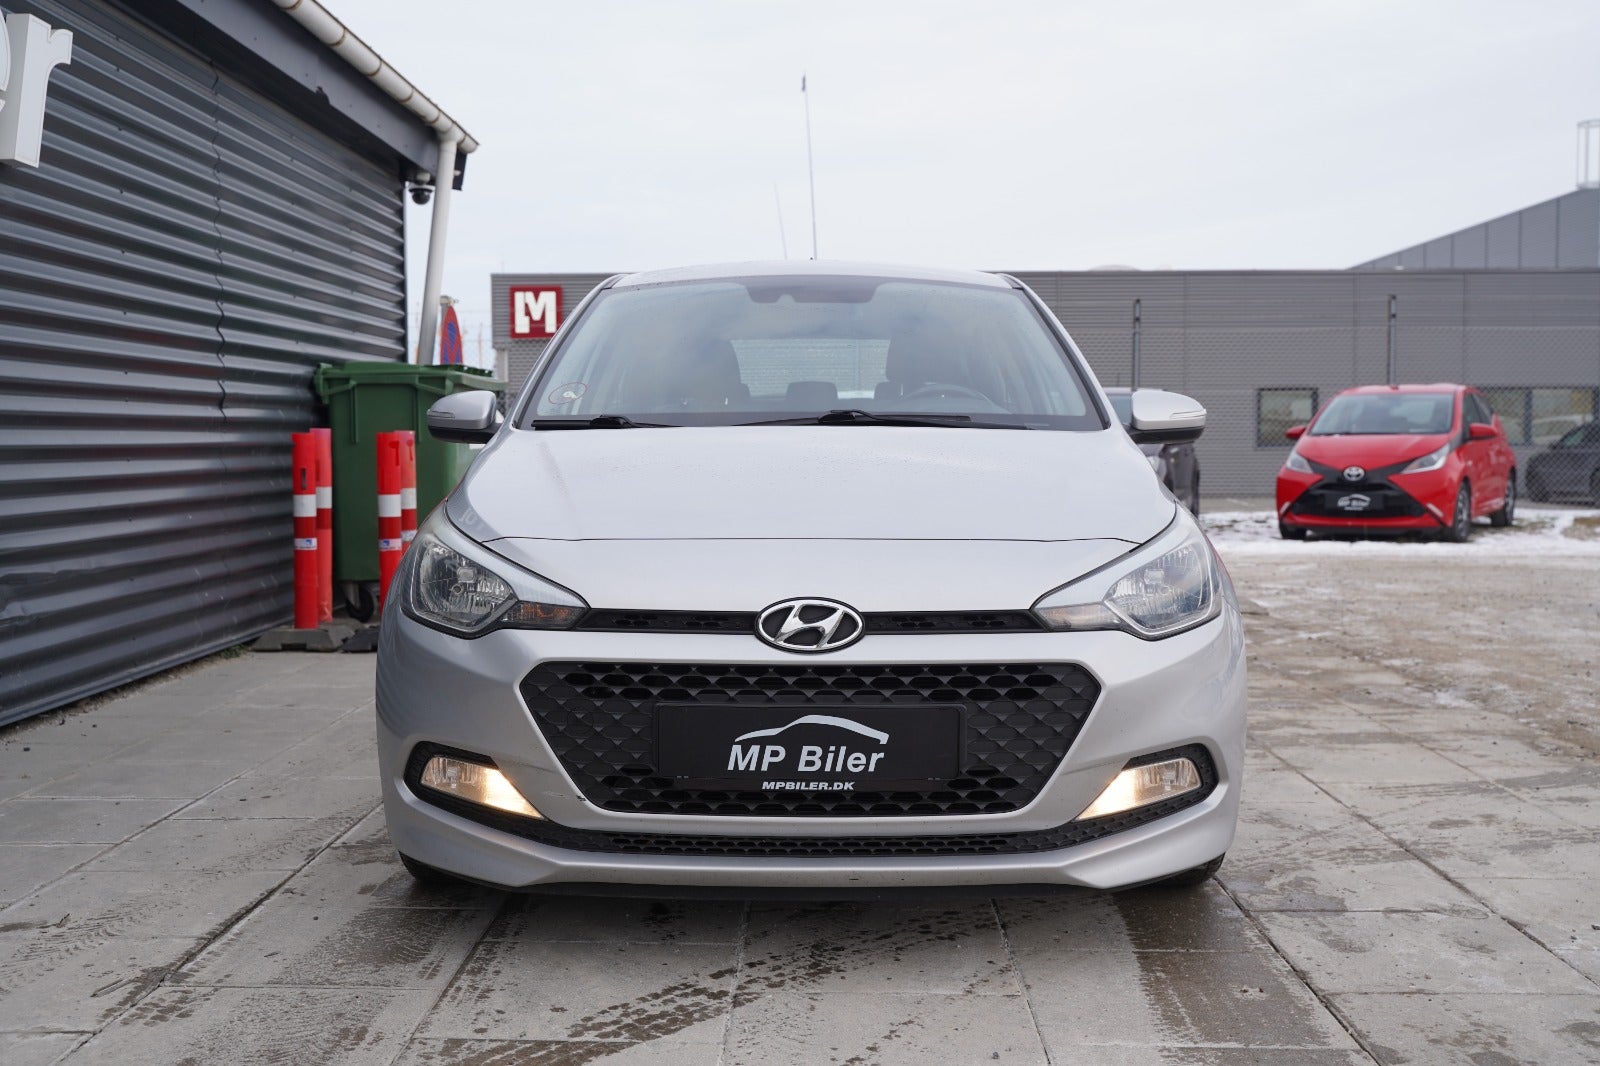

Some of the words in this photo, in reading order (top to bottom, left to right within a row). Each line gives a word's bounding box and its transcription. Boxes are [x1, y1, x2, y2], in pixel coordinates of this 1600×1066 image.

[0, 5, 73, 168] r
[728, 744, 786, 771] MP
[798, 745, 885, 772] Biler
[761, 781, 855, 791] MPBILER.DK
